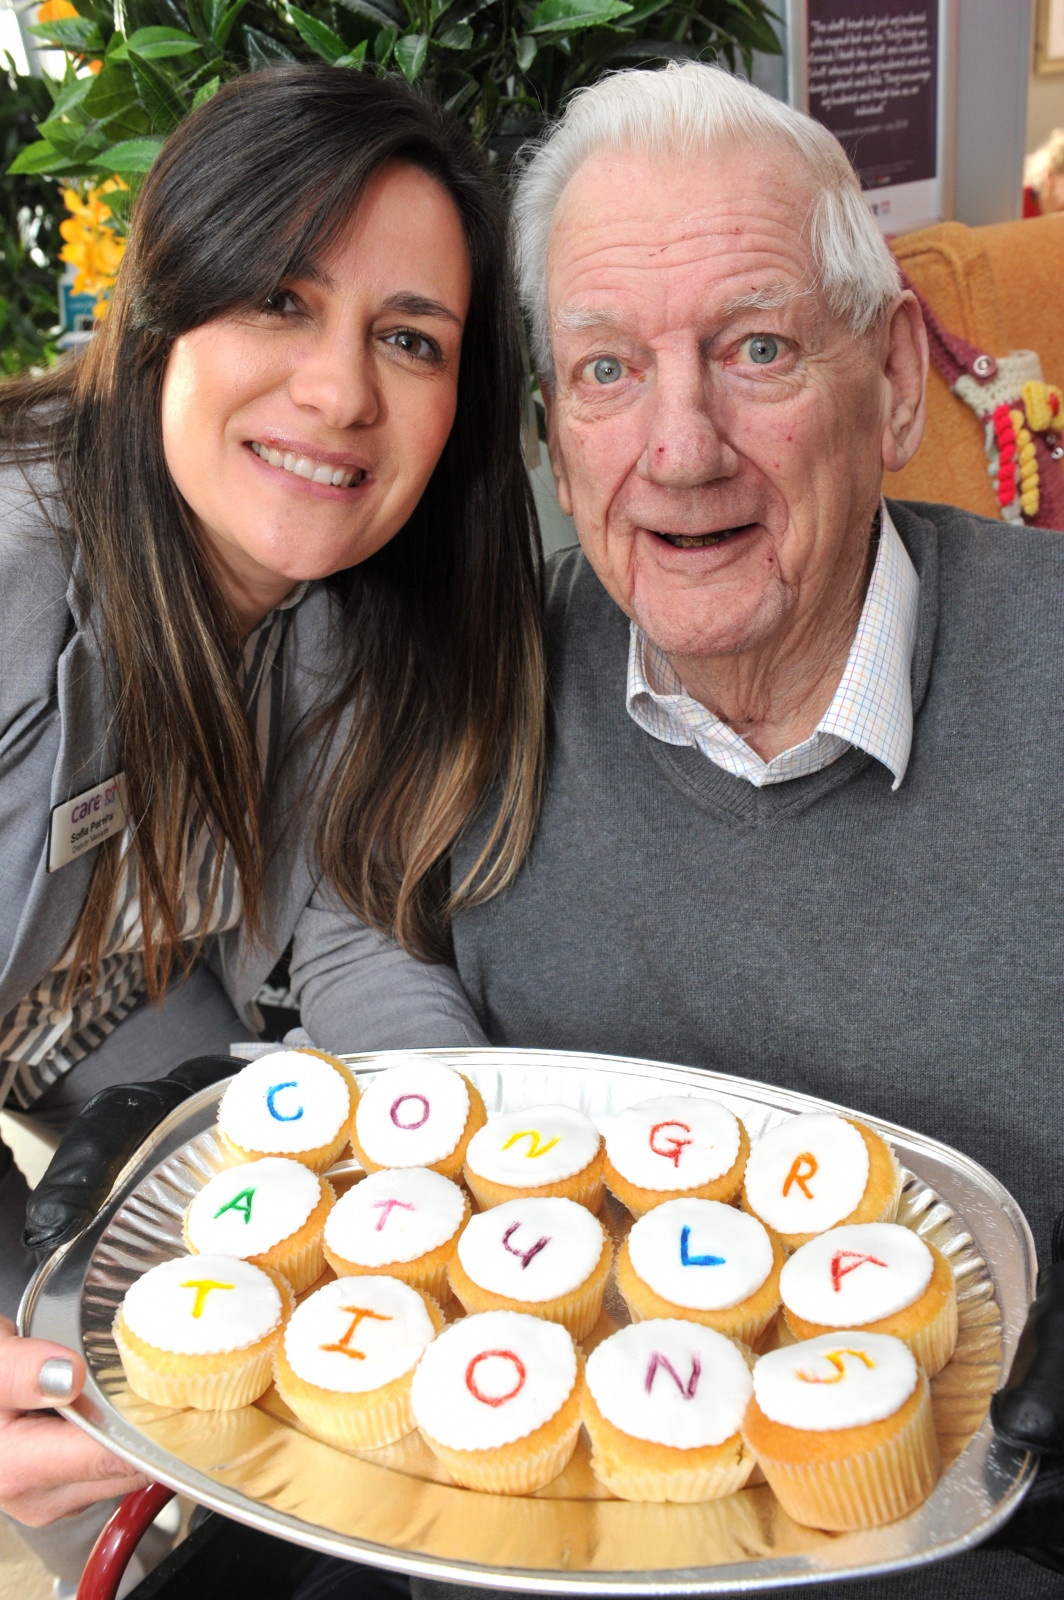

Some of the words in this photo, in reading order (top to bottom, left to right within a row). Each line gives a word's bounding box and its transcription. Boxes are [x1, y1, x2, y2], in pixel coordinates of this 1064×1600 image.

[71, 827, 89, 843] Sofia
[72, 794, 102, 823] care
[267, 1081, 303, 1121] C
[390, 1094, 430, 1130] O
[649, 1120, 692, 1167] G
[783, 1152, 819, 1200] R
[214, 1186, 257, 1225] A
[372, 1199, 416, 1231] T
[680, 1224, 726, 1267] L
[831, 1250, 888, 1292] A
[180, 1280, 234, 1318] T
[318, 1305, 394, 1360] I
[465, 1349, 526, 1407] O
[645, 1350, 701, 1400] N
[795, 1347, 876, 1385] S
